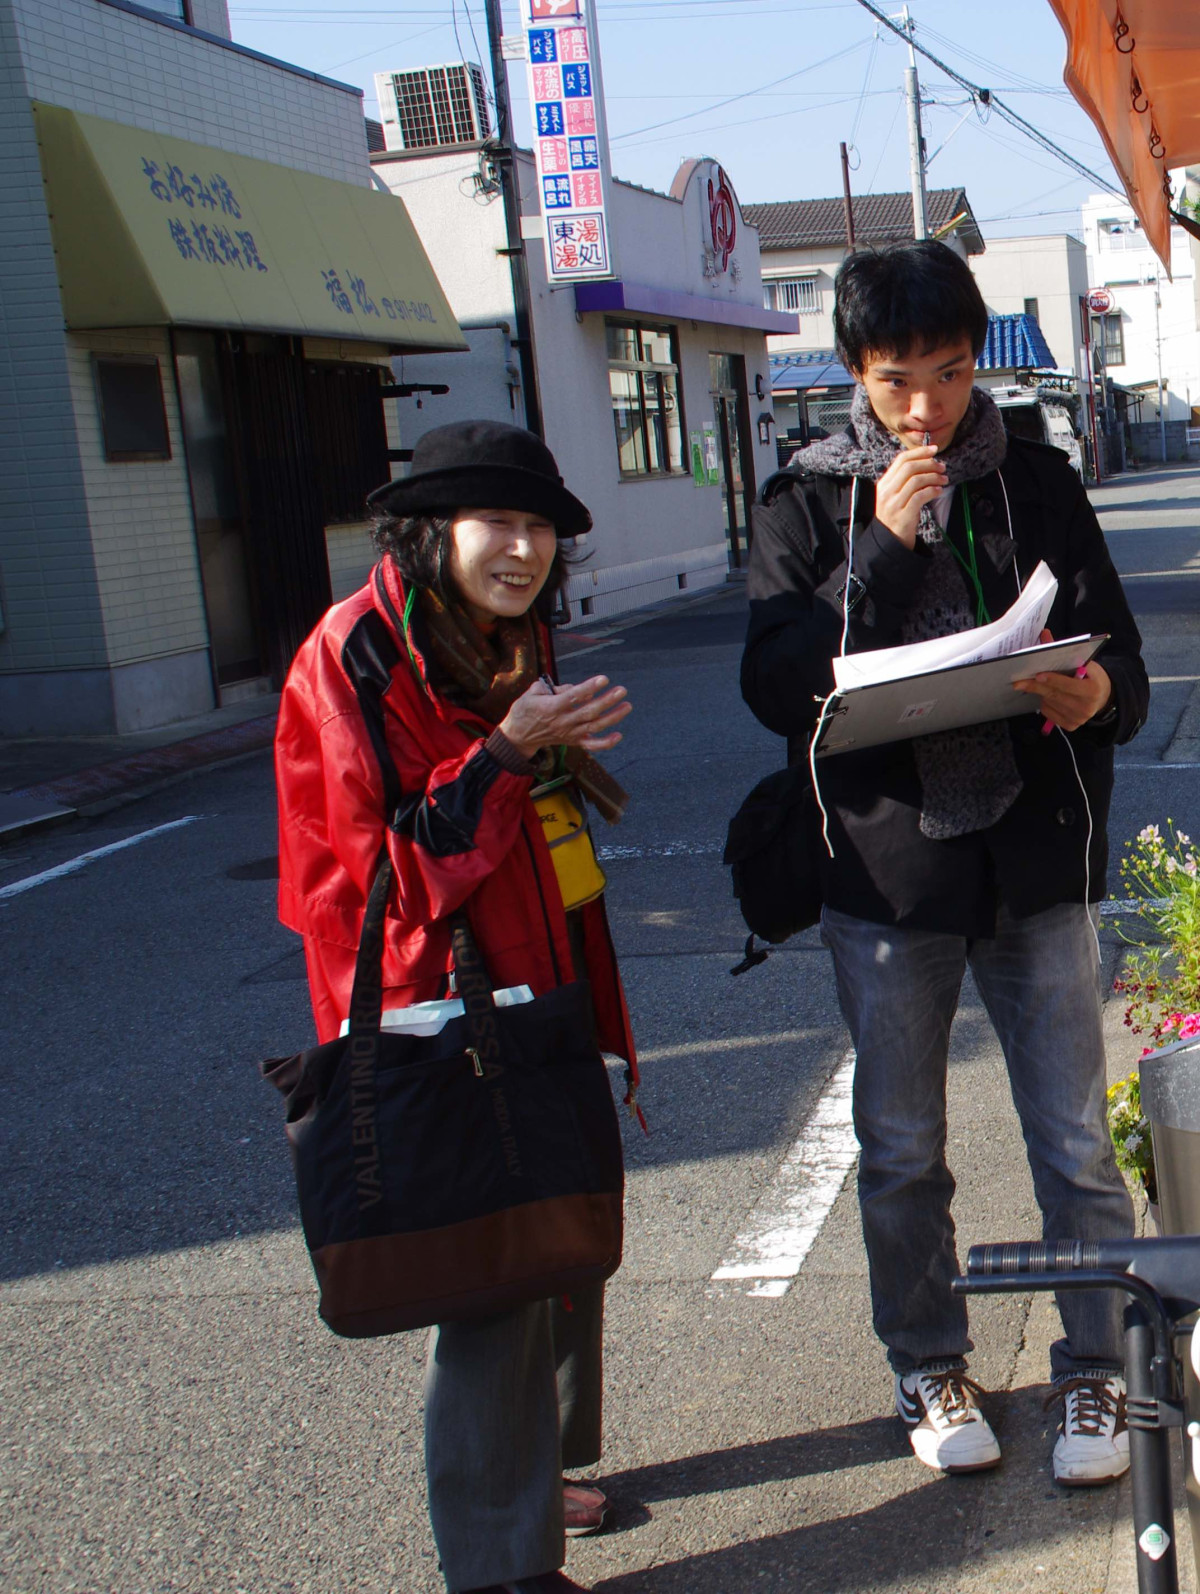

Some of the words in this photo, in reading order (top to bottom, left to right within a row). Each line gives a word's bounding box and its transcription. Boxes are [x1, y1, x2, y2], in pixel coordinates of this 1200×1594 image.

[532, 38, 542, 56] バス
[571, 29, 587, 60] 高圧
[534, 68, 545, 99] マッサージ
[544, 66, 560, 99] 水流の
[566, 73, 576, 90] バス
[577, 65, 588, 96] ジェット
[539, 107, 550, 133] サウナ
[551, 106, 561, 132] ミスト
[570, 140, 584, 167] 風呂
[583, 139, 598, 166] 露天
[141, 156, 242, 220] お好み焼
[544, 179, 558, 206] 風呂
[557, 178, 570, 204] 流れ
[576, 175, 587, 206] イオンの
[588, 174, 599, 205] マイナス
[707, 164, 737, 273] ゆ
[168, 217, 269, 273] 鉄板料理
[460, 972, 505, 1083] ROSSA
[350, 1033, 384, 1212] VALENTINO
